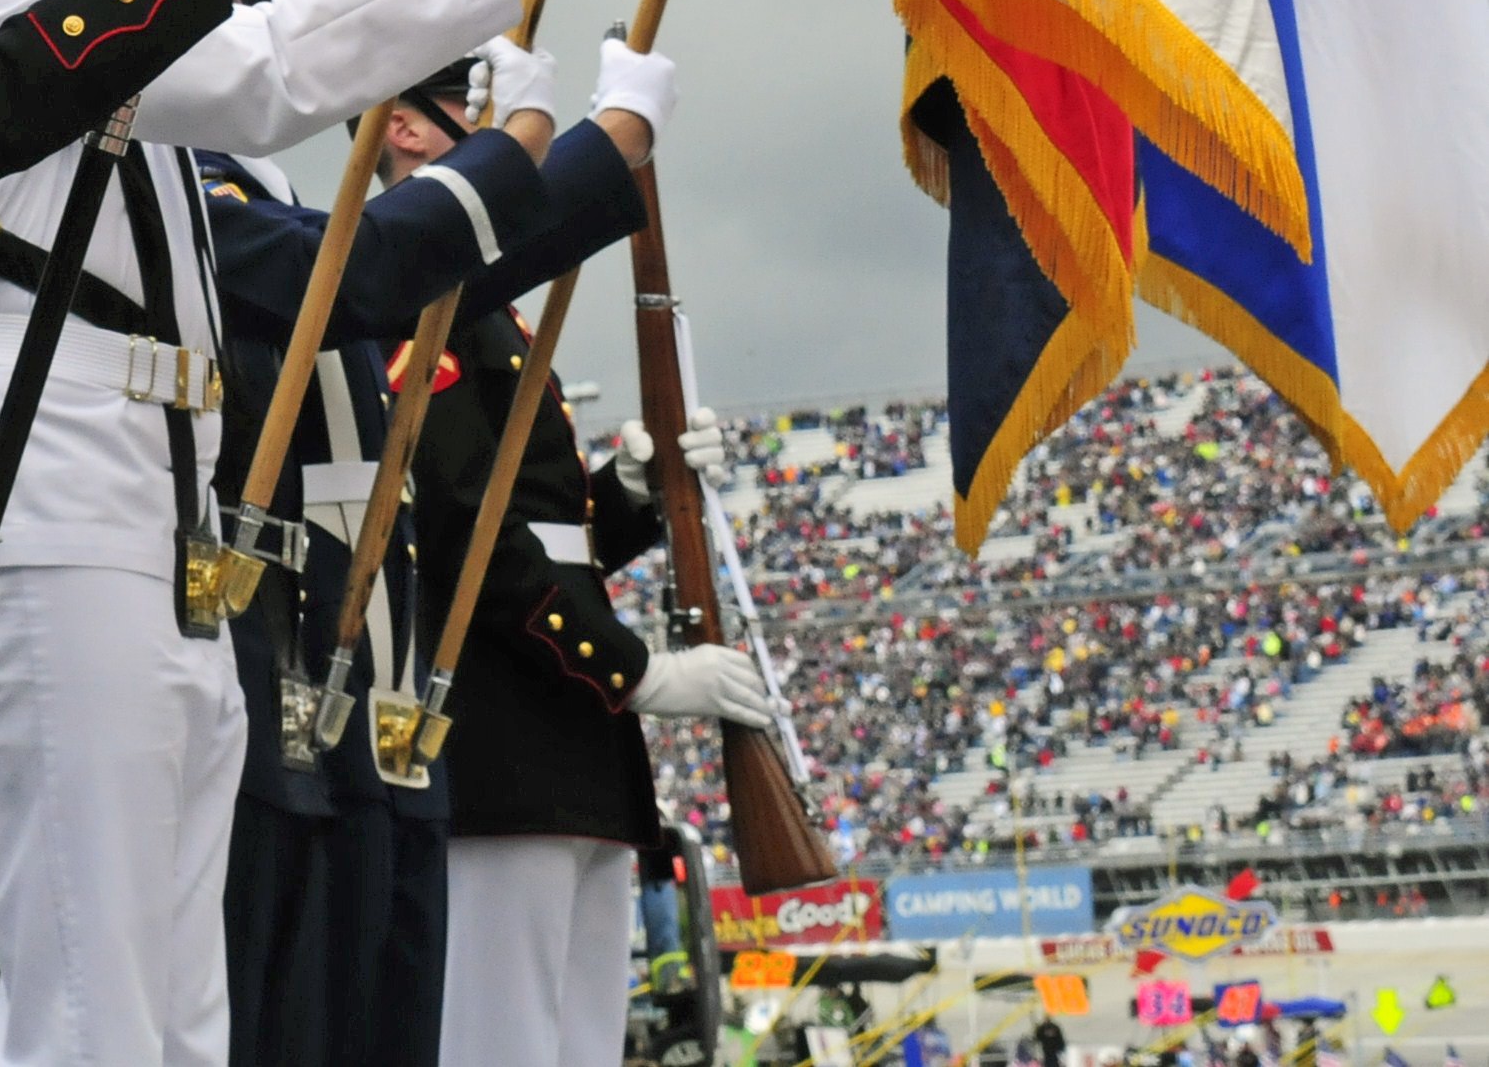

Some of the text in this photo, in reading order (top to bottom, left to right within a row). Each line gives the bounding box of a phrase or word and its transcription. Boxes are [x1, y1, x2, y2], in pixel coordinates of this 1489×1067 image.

[895, 883, 1083, 918] CAMPING WORLD
[1128, 912, 1263, 940] SUNOCO
